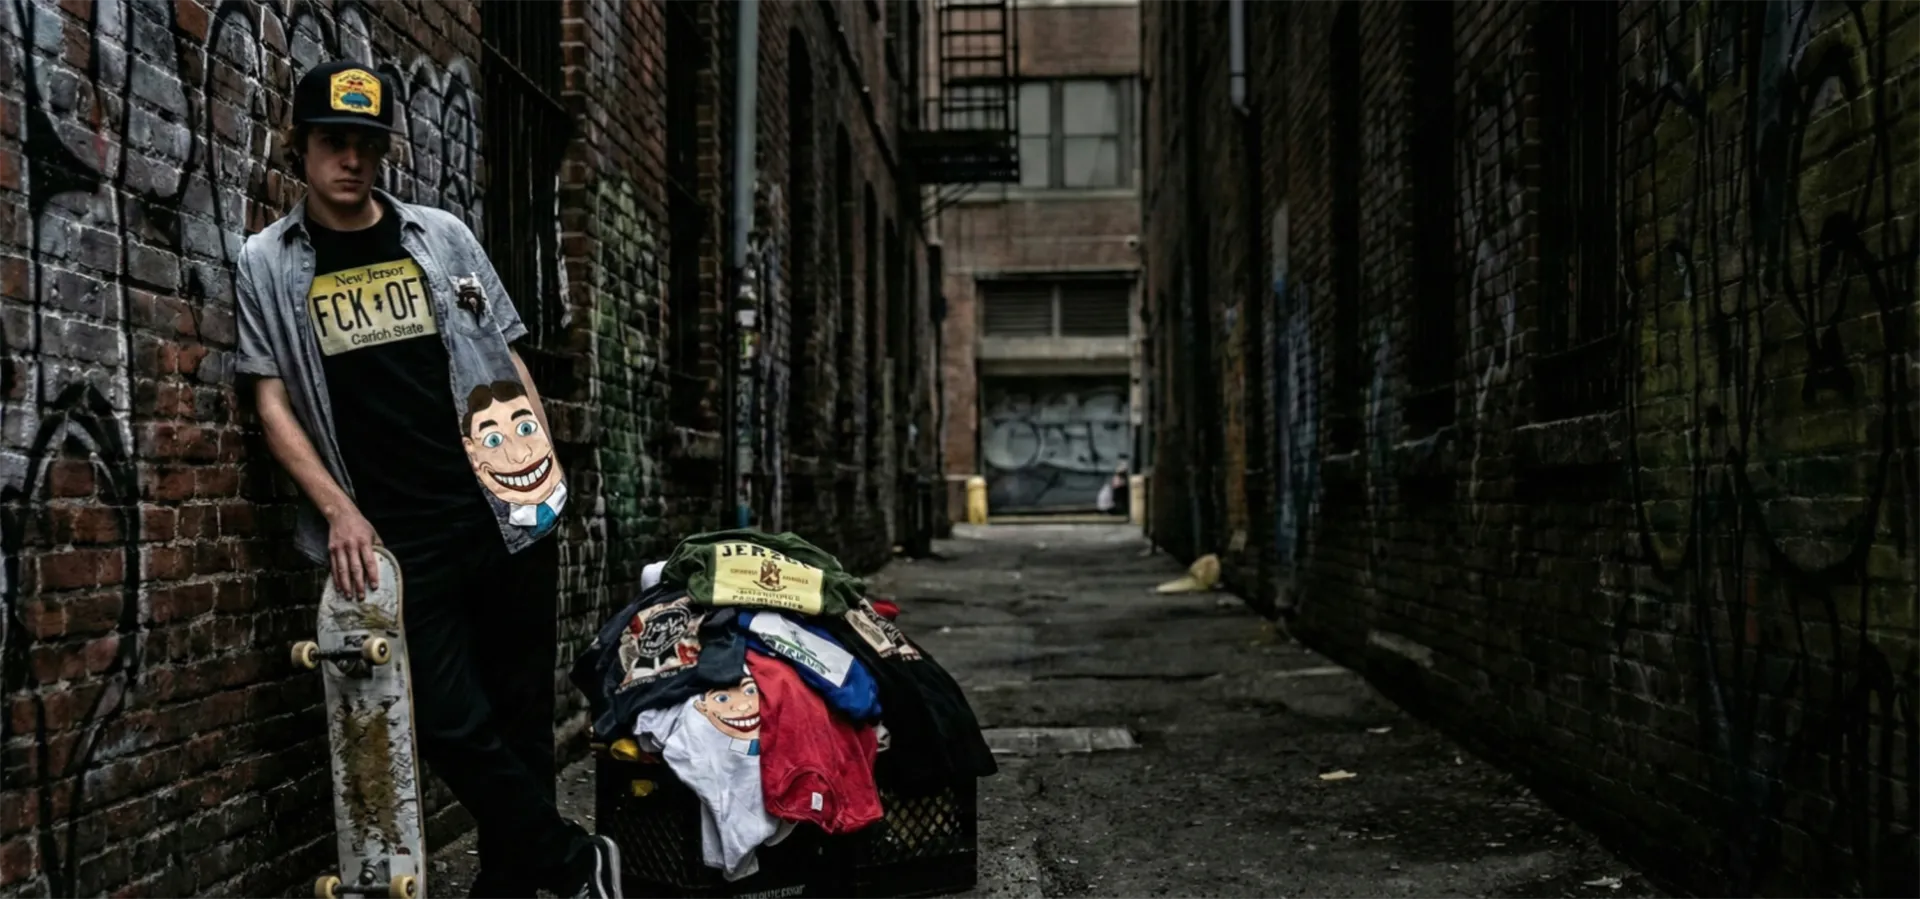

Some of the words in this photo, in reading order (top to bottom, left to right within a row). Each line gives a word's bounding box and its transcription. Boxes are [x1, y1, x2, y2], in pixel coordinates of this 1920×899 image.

[334, 273, 364, 287] New
[312, 288, 373, 338] FCK
[393, 323, 425, 338] State
